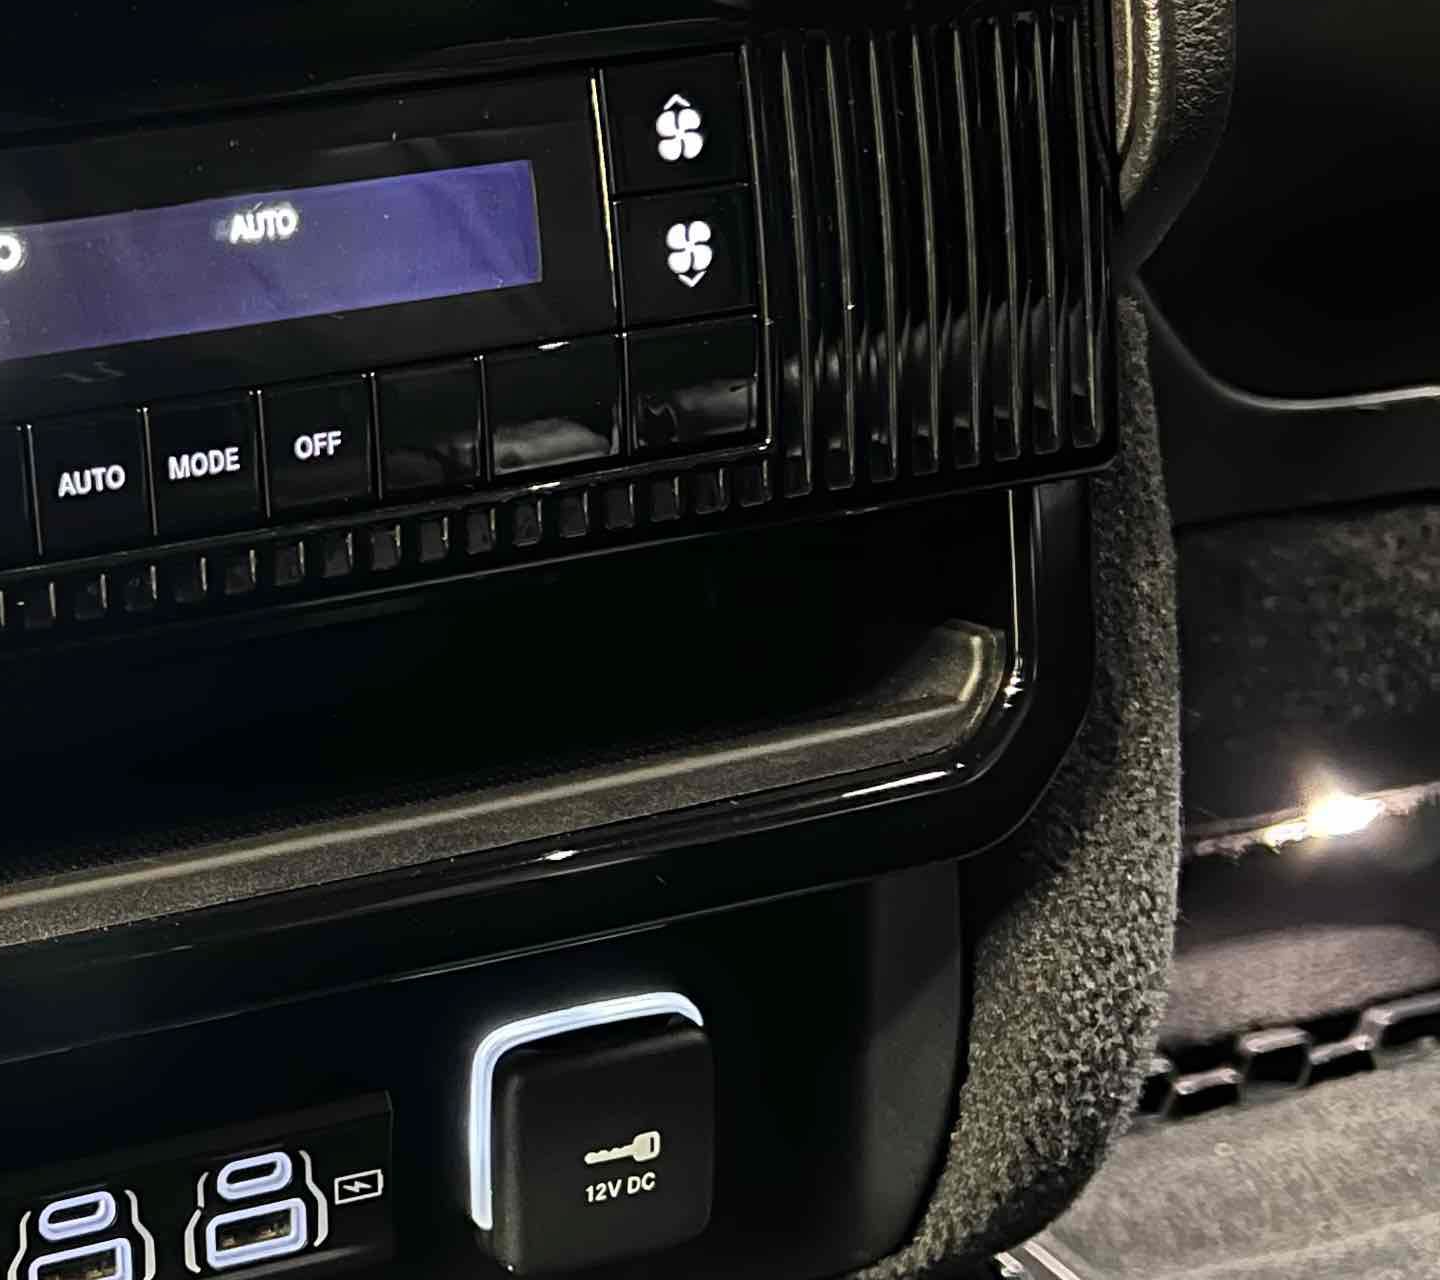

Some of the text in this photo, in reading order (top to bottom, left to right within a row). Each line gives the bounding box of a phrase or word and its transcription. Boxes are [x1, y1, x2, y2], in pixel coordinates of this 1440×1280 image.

[229, 207, 299, 245] AUTO
[293, 430, 342, 460] OFF
[167, 447, 241, 480] MODE
[57, 465, 126, 497] AUTO
[585, 1171, 657, 1203] 12V DC
